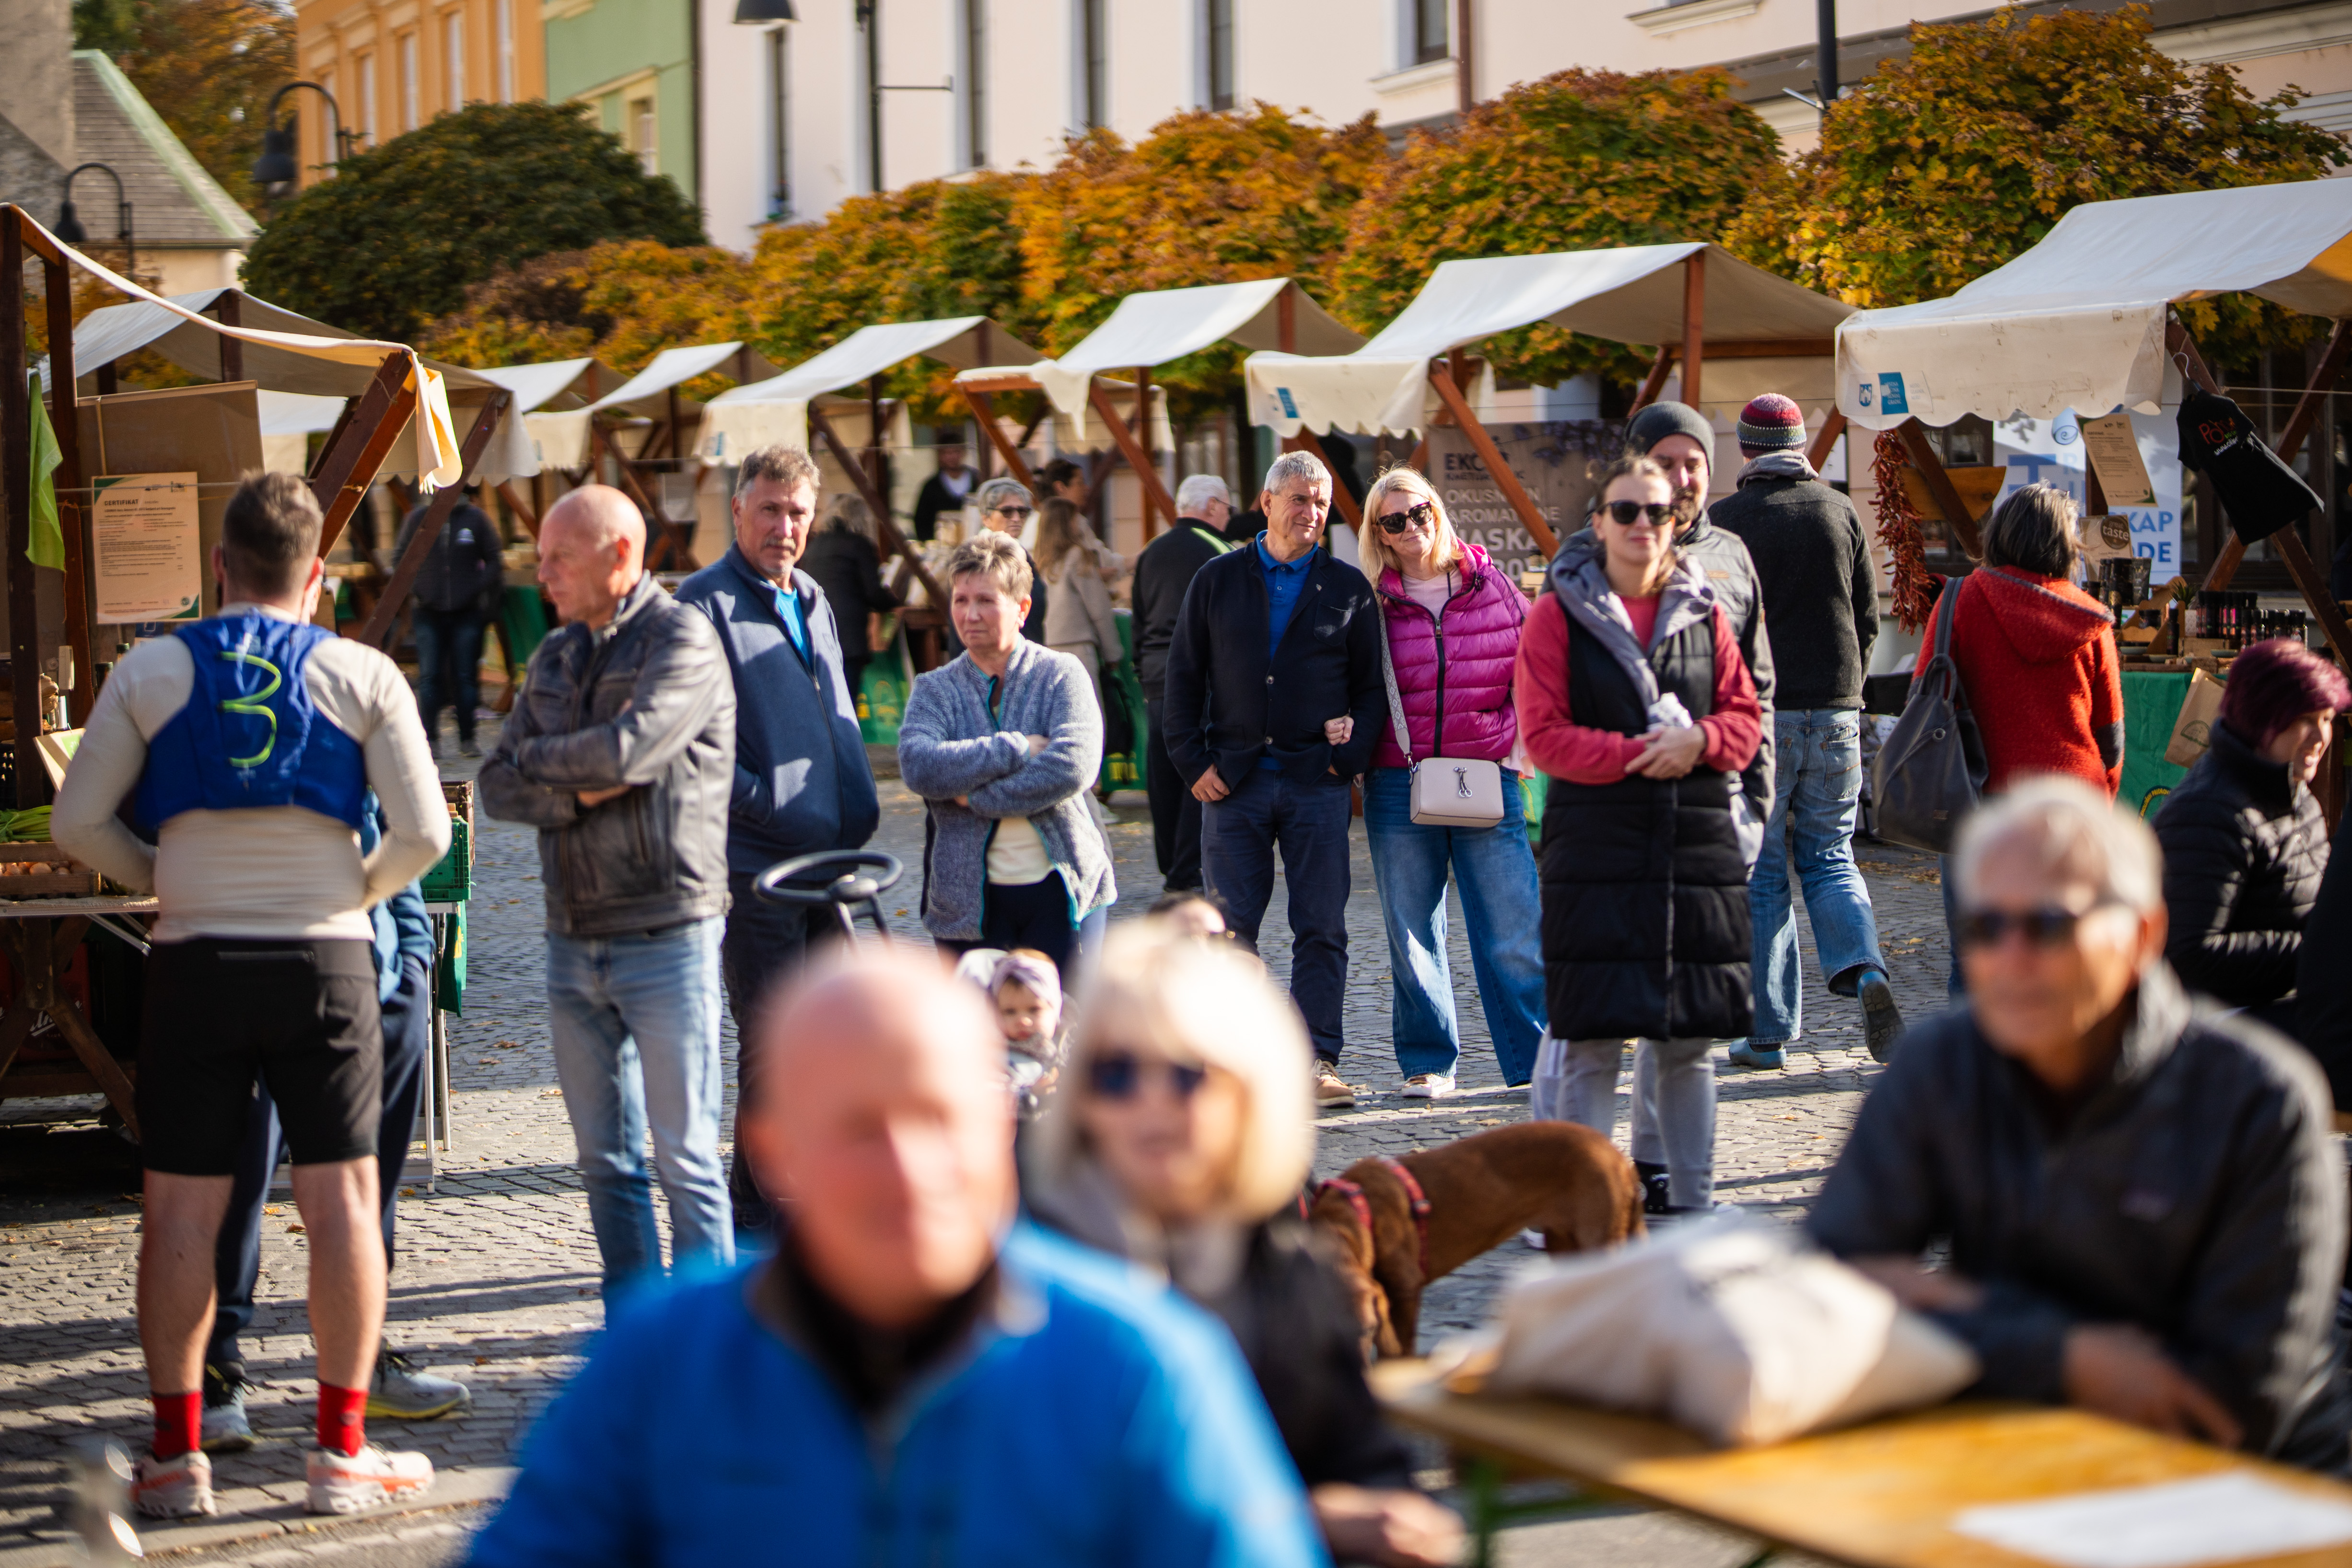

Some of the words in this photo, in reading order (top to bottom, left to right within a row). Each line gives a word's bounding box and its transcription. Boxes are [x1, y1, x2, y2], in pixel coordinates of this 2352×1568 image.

[1445, 488, 1508, 503] OKUSN
[1448, 506, 1559, 523] AROMATNE
[2103, 525, 2129, 541] taste
